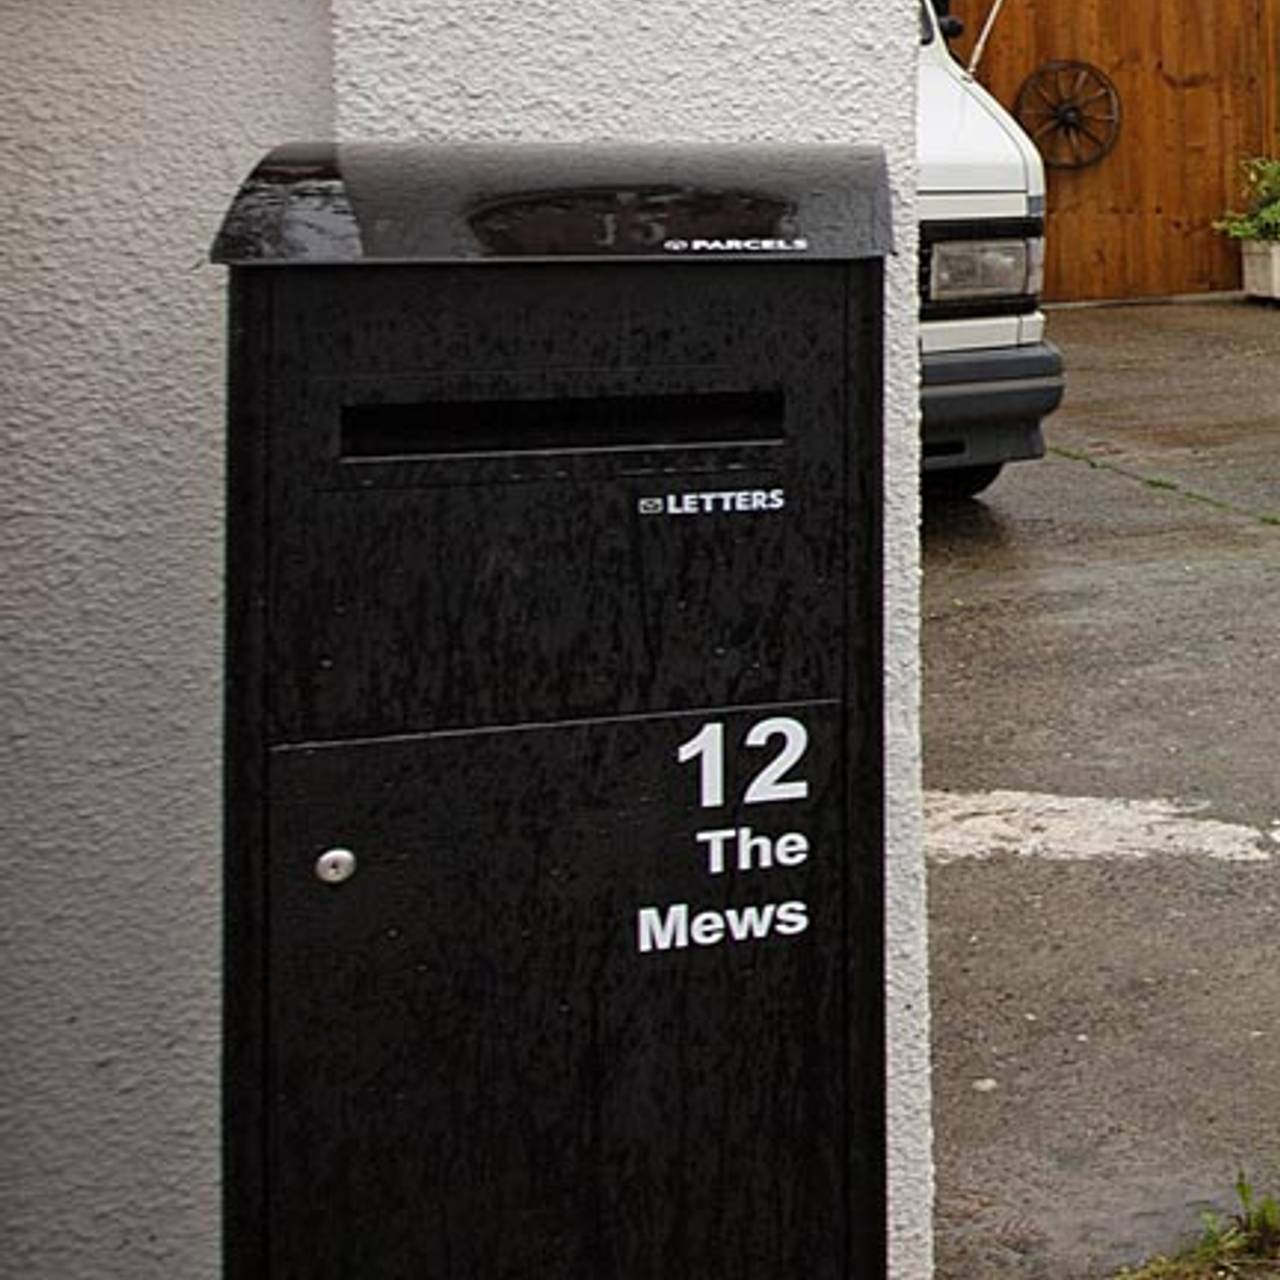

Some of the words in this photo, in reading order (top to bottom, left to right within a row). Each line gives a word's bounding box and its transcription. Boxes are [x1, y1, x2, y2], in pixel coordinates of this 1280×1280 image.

[690, 237, 808, 251] PARCELS
[666, 488, 785, 514] LETTERS
[677, 717, 809, 808] 12
[696, 827, 809, 874] The
[638, 901, 808, 952] Mews
